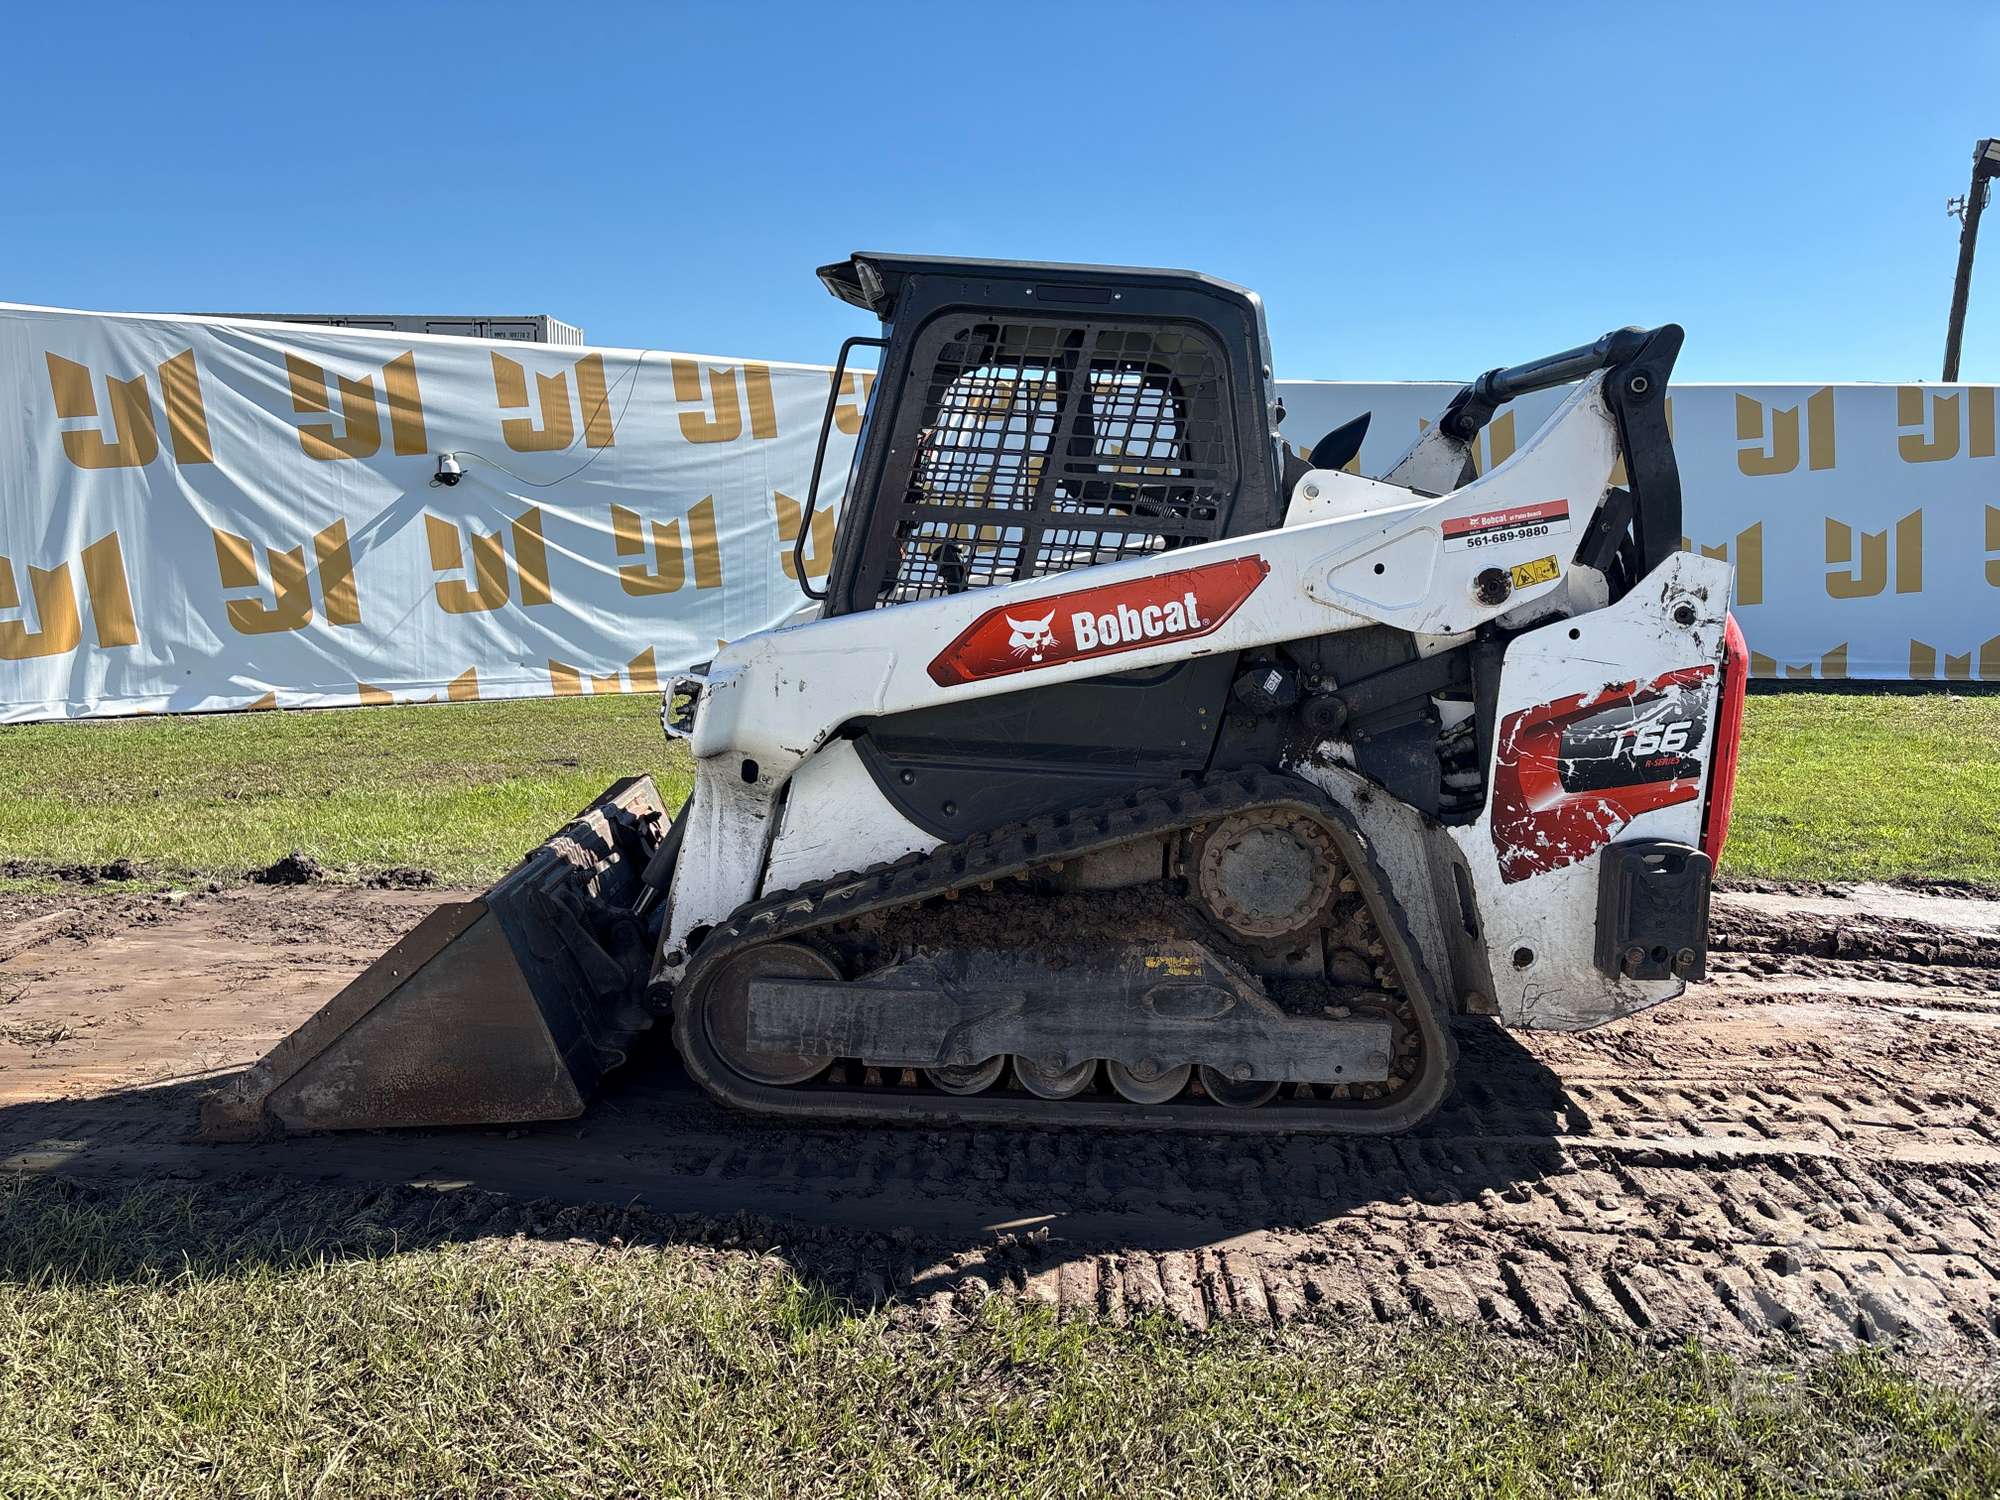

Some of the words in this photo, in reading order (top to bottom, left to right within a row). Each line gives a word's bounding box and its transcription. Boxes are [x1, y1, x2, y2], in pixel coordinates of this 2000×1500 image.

[1480, 513, 1508, 526] Bobcat
[1467, 525, 1549, 548] 561-689-9880
[1071, 592, 1201, 651] Bobcat
[1645, 757, 1681, 768] R-SERIES
